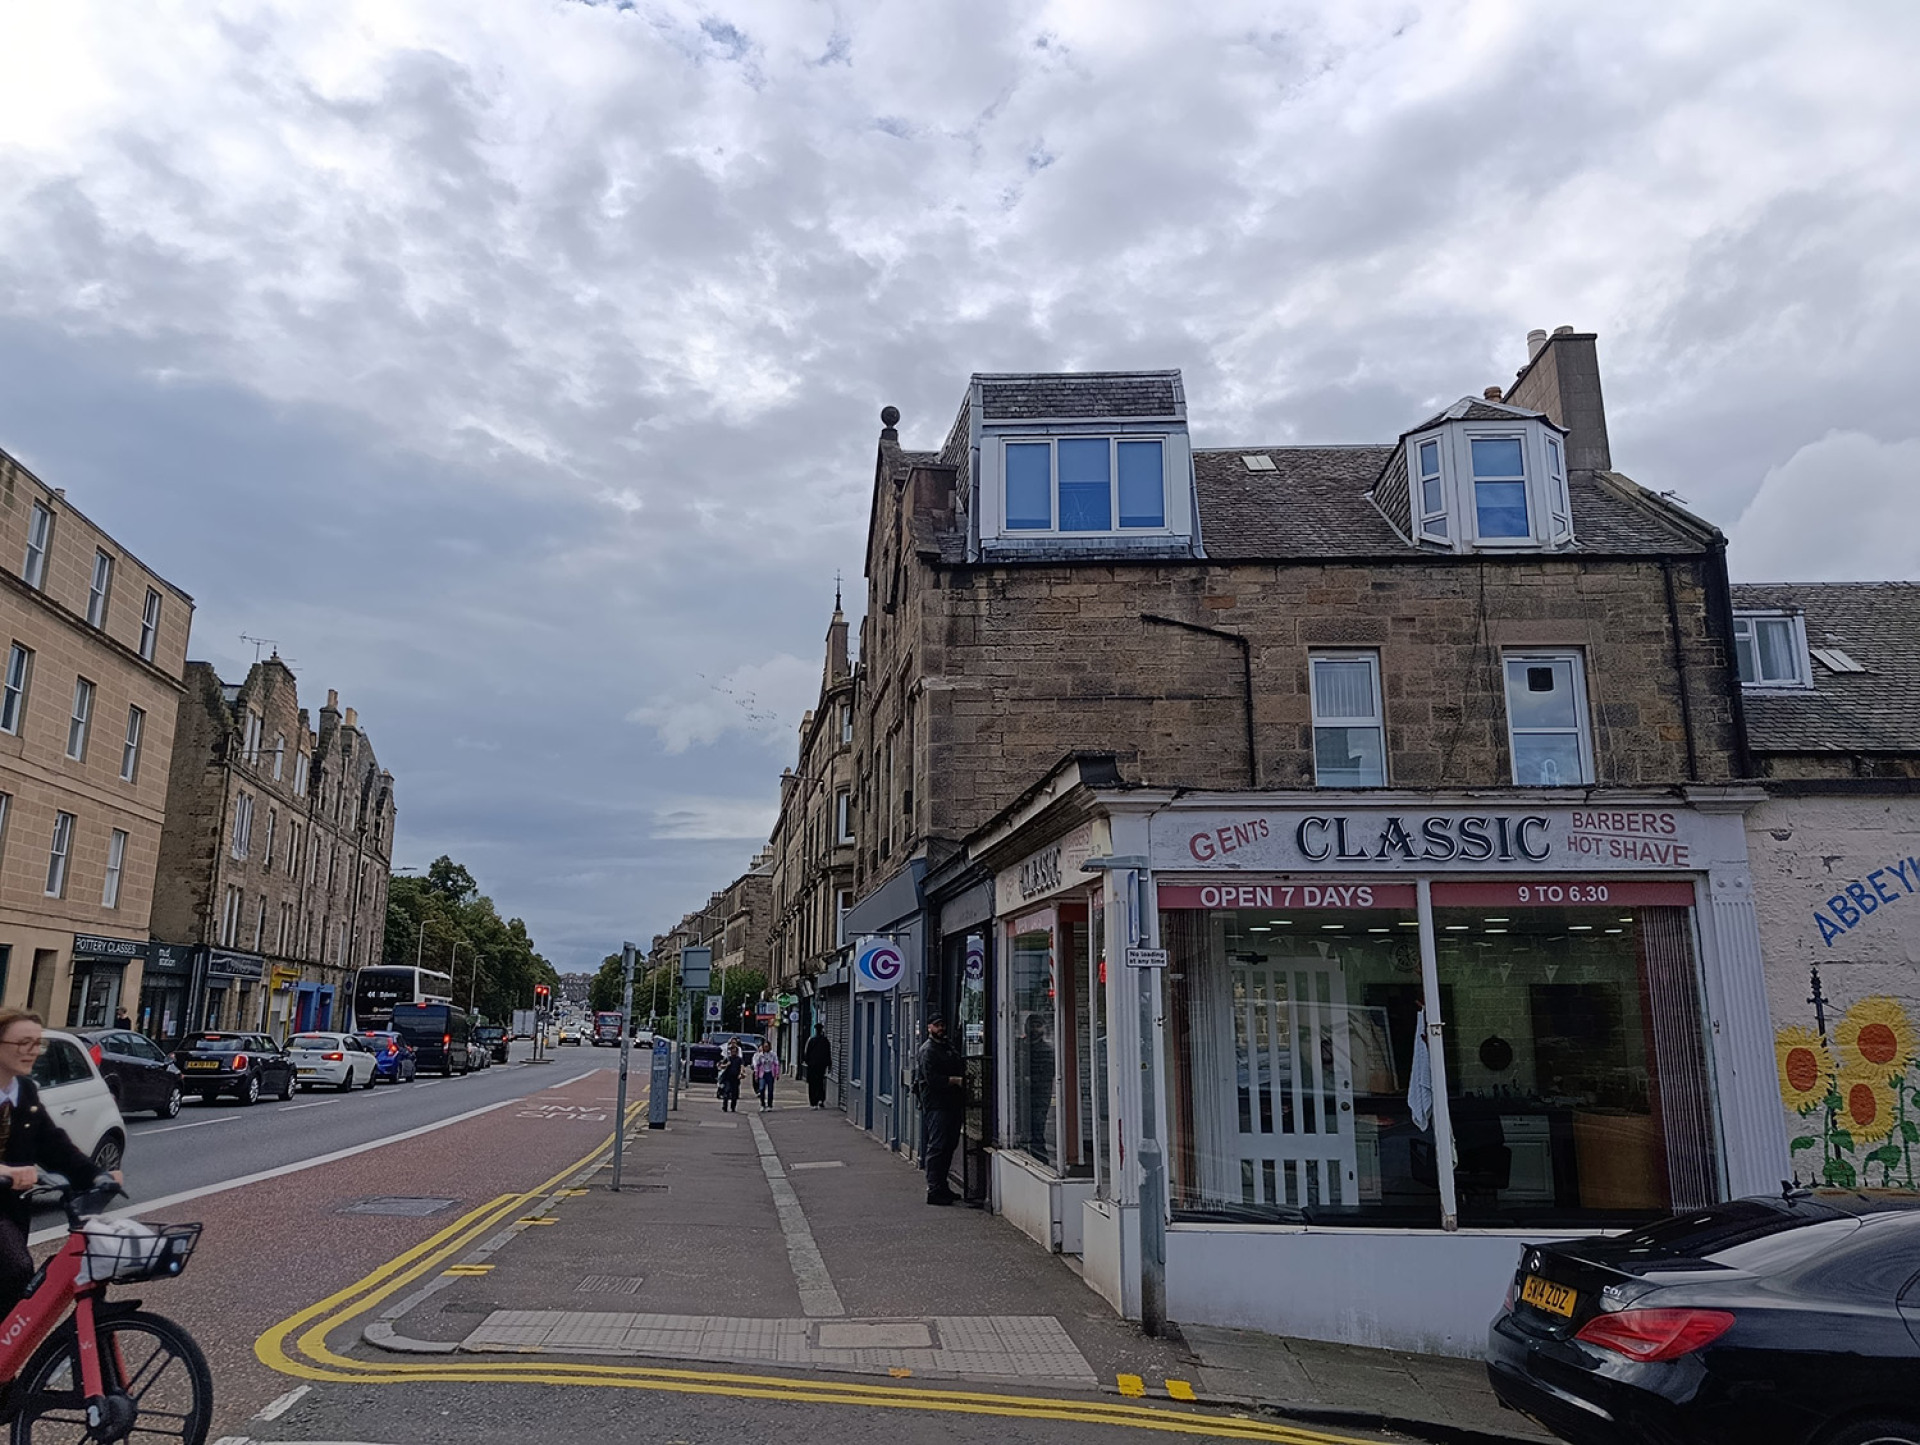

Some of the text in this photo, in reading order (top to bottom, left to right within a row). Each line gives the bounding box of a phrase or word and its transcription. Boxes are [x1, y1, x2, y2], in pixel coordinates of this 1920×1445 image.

[1571, 811, 1677, 834] BARBERS
[1189, 815, 1552, 862] GENTS CLASSIC
[1567, 835, 1691, 868] HOT SHAVE
[1200, 886, 1374, 907] OPEN 7 DAYS
[1518, 886, 1609, 902] 9 TO 6.30
[76, 937, 137, 955] POTTERY CLASSES
[1140, 951, 1165, 959] loading
